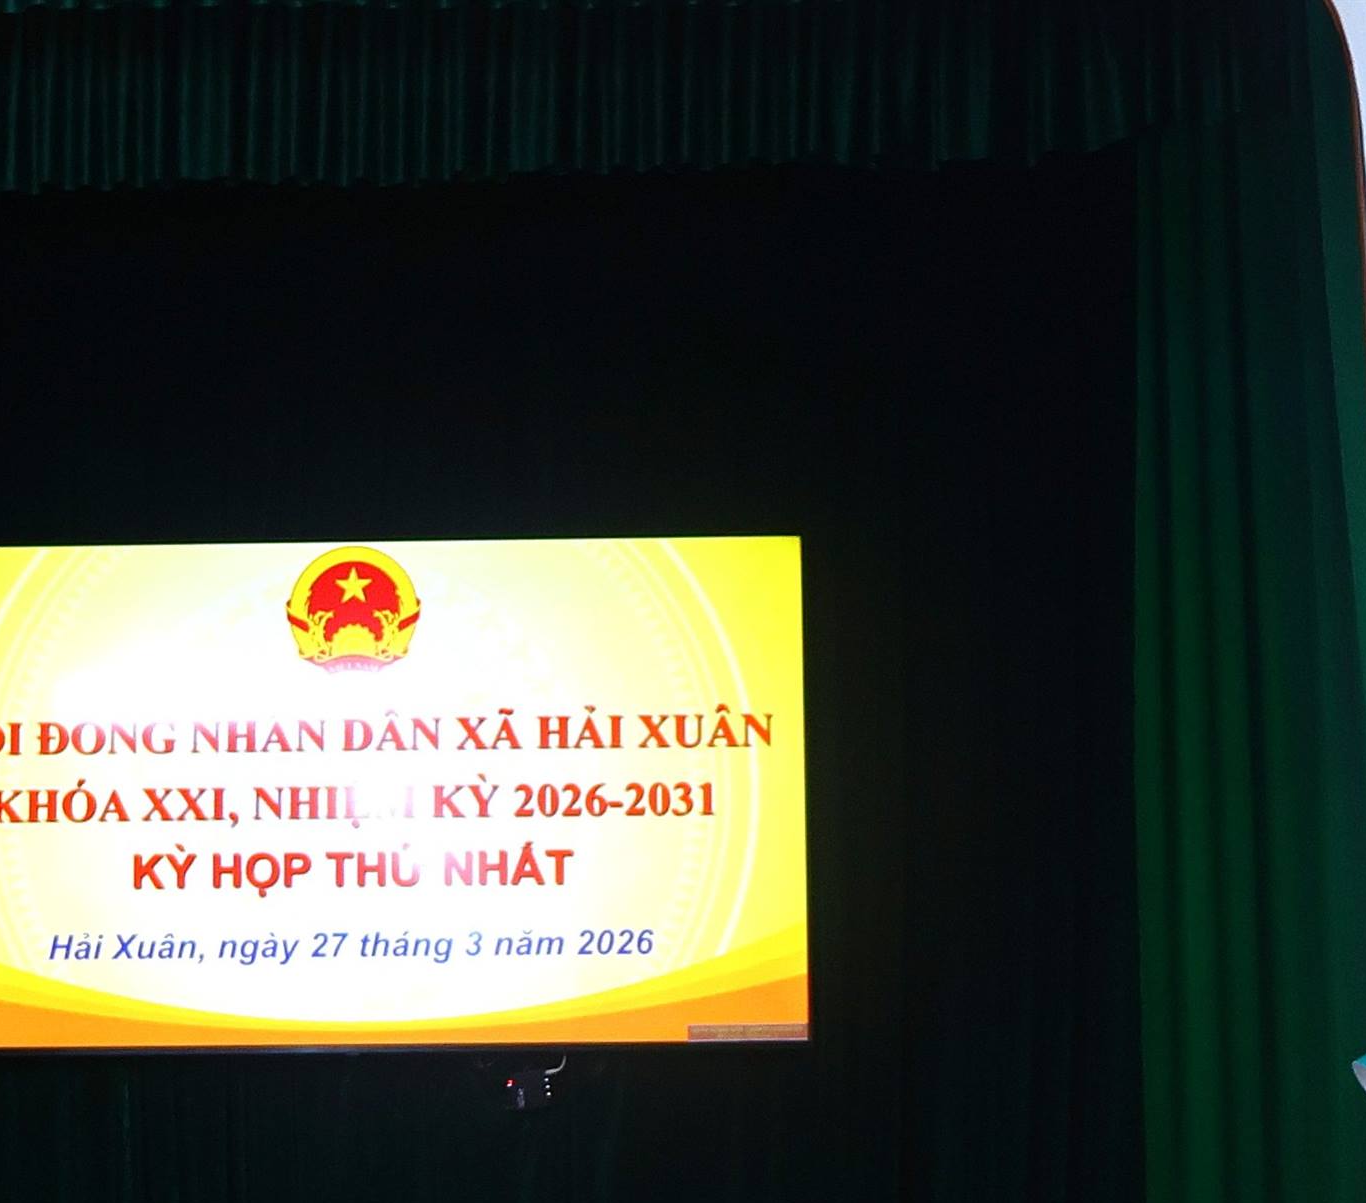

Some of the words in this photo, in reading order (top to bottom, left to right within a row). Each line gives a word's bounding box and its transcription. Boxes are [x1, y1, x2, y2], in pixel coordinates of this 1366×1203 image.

[343, 709, 440, 751] DÂN
[457, 708, 522, 750] XÃ
[537, 705, 623, 749] HẢI
[638, 704, 772, 748] XUÂN
[142, 787, 238, 828] XXI,
[433, 774, 499, 818] KỲ
[514, 782, 714, 817] 2026-2031
[133, 843, 197, 889] KỲ
[212, 852, 312, 897] HỌP
[49, 933, 104, 960] Hải
[112, 933, 204, 964] Xuân,
[218, 932, 299, 966] ngày
[311, 933, 347, 958] 27
[360, 931, 453, 963] tháng
[465, 931, 484, 956] 3
[494, 929, 564, 956] năm
[578, 929, 654, 955] 2026
